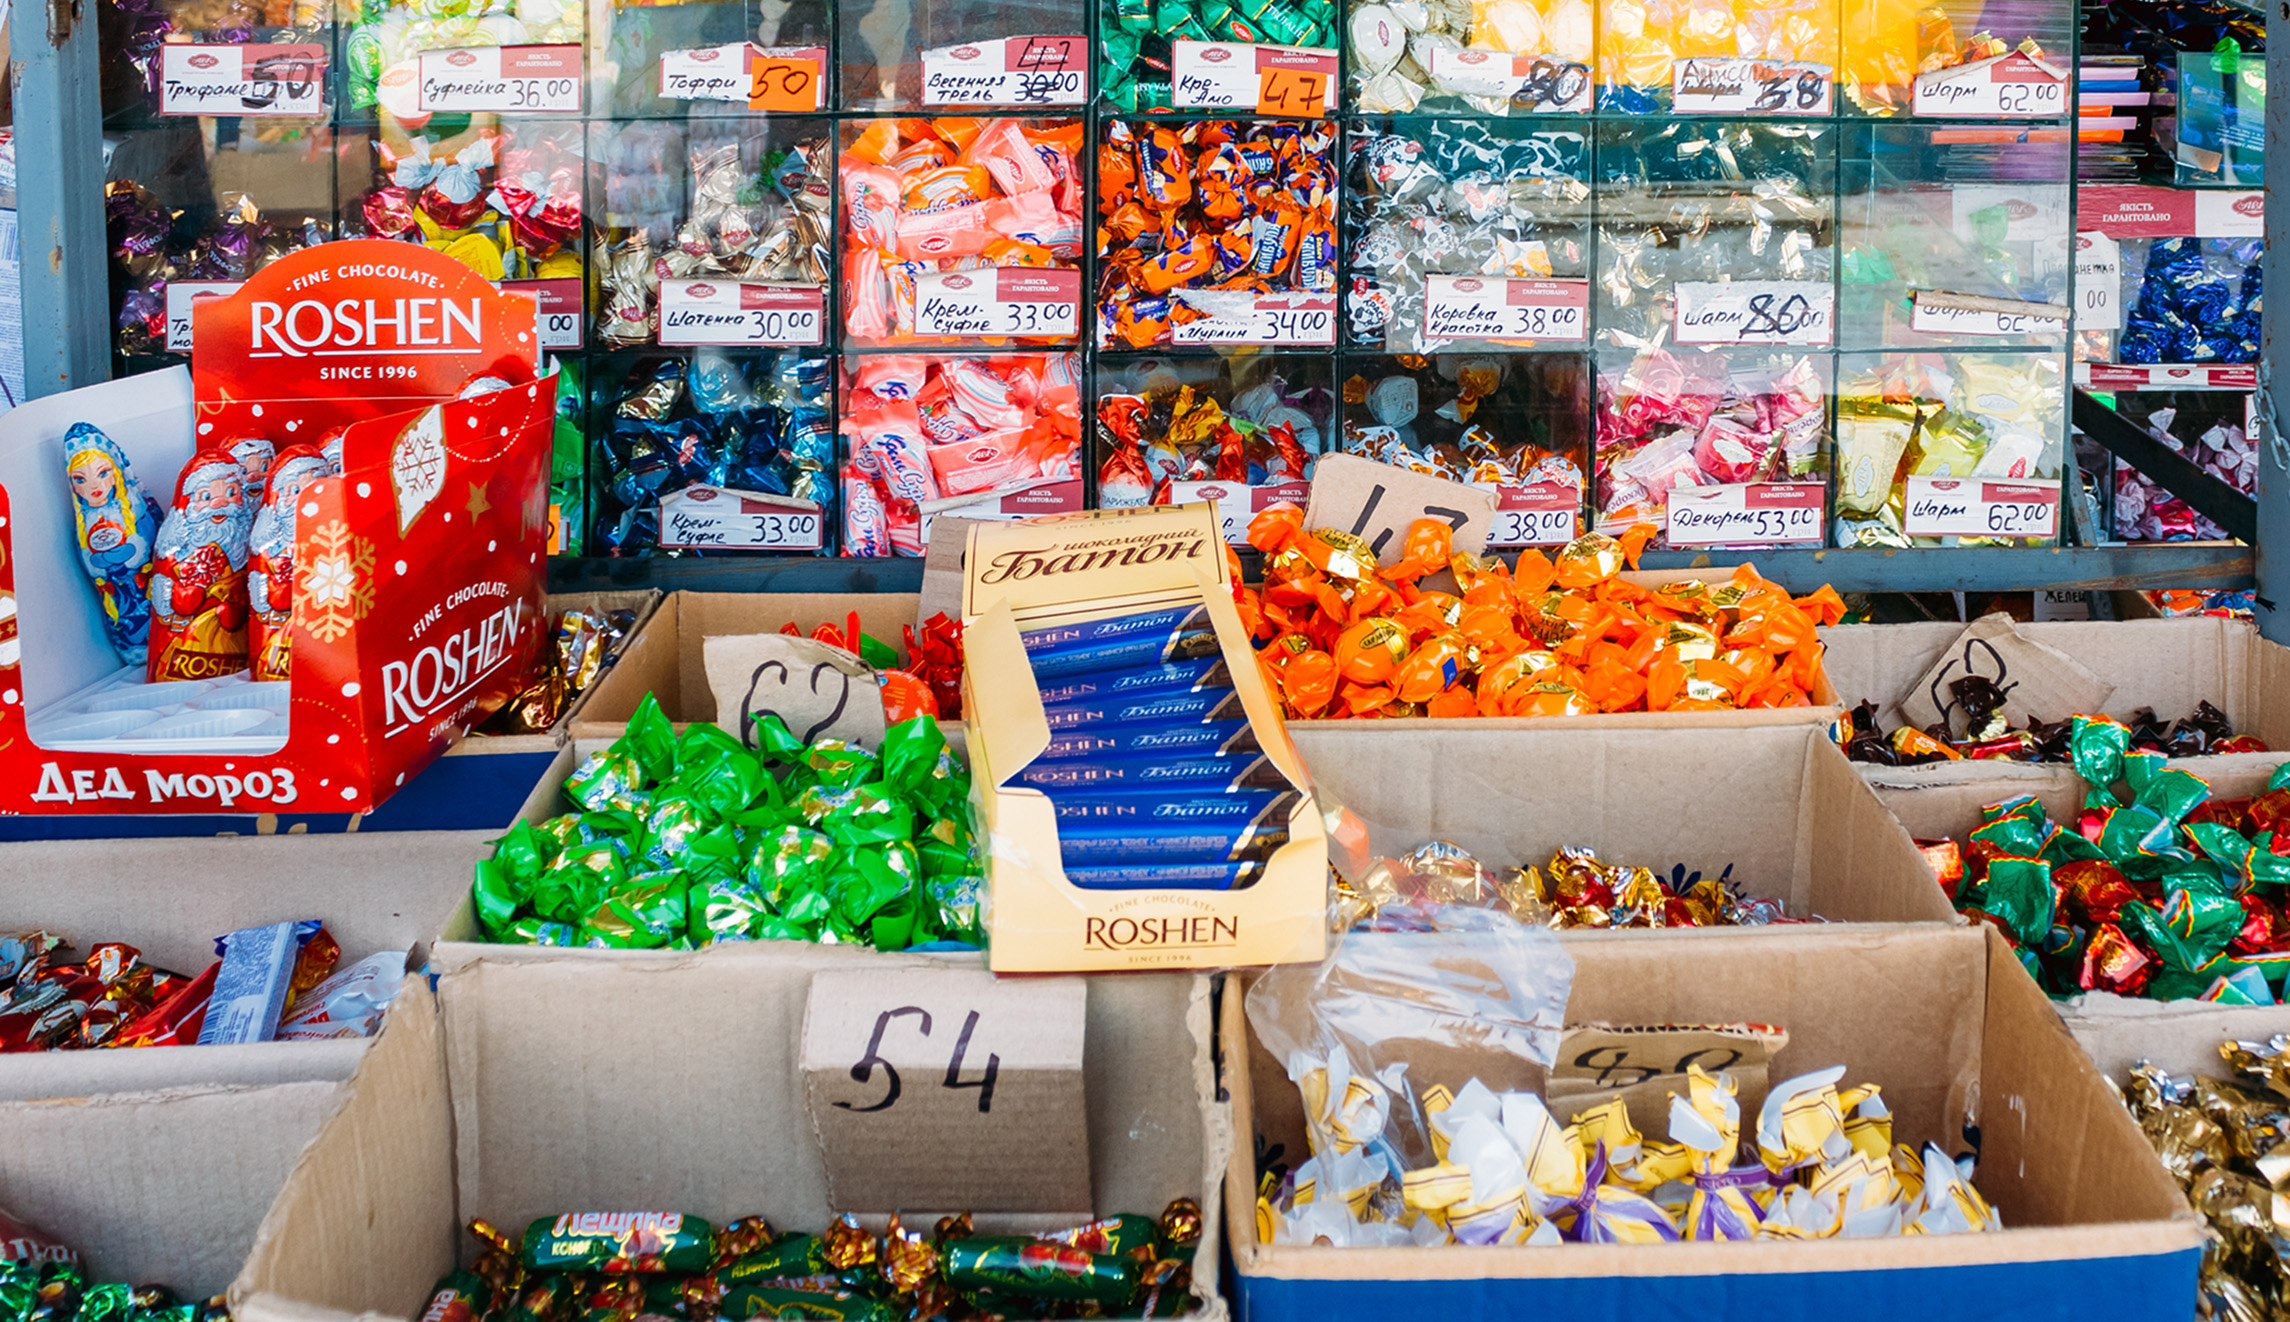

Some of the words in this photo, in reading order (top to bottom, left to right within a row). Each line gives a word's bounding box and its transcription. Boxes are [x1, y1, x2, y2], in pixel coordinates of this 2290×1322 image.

[1271, 56, 1319, 64] ГАРАНТОВАНО
[423, 78, 507, 102] Суфлейка
[669, 75, 737, 95] Тоффи
[747, 66, 809, 99] 50
[927, 72, 1006, 88] Весенняя
[1263, 72, 1324, 111] 47
[1999, 84, 2058, 112] 62.00
[2102, 213, 2171, 223] ГАРАНТОВАНО
[2119, 203, 2154, 212] ЯКІСТЬ
[292, 268, 330, 291] FINE
[337, 263, 439, 289] CHOCOLATE
[1012, 285, 1060, 293] ГАРАНТОВАНО
[249, 297, 482, 357] ROSHEN
[667, 311, 745, 327] Шатенка
[748, 311, 813, 340] 30.00
[1005, 303, 1071, 332] 33.00
[1262, 311, 1327, 340] 34.00
[1430, 303, 1498, 322] Коровка
[1514, 307, 1577, 335] 38.00
[319, 366, 372, 380] SINCE
[378, 365, 418, 379] 1996
[750, 516, 816, 543] 33.00
[1503, 511, 1569, 541] 38.00
[1673, 508, 1754, 531] Декорель
[1754, 507, 1815, 538] 53.00
[1912, 500, 1967, 521] Шарм
[1988, 503, 2048, 532] 62.00
[1063, 528, 1206, 551] шоколадний
[980, 537, 1211, 586] Батон
[413, 603, 443, 639] FINE
[446, 581, 508, 611] CHOCOLATE
[1093, 612, 1175, 636] Батон
[382, 596, 523, 724] ROSHEN
[1112, 668, 1196, 690] Батон
[1119, 700, 1206, 719] Батон
[1130, 730, 1221, 749] Батон
[30, 762, 136, 805] ДЕД
[1023, 768, 1125, 783] ROSHEN
[1140, 764, 1232, 781] Батон
[1153, 802, 1249, 818] Батон
[1114, 898, 1139, 912] FINE
[1144, 894, 1213, 912] CHOCOLATE
[1084, 916, 1239, 952] ROSHEN
[1127, 955, 1162, 964] SINCE
[1166, 953, 1192, 963] 1996
[831, 1005, 1001, 1114] 54
